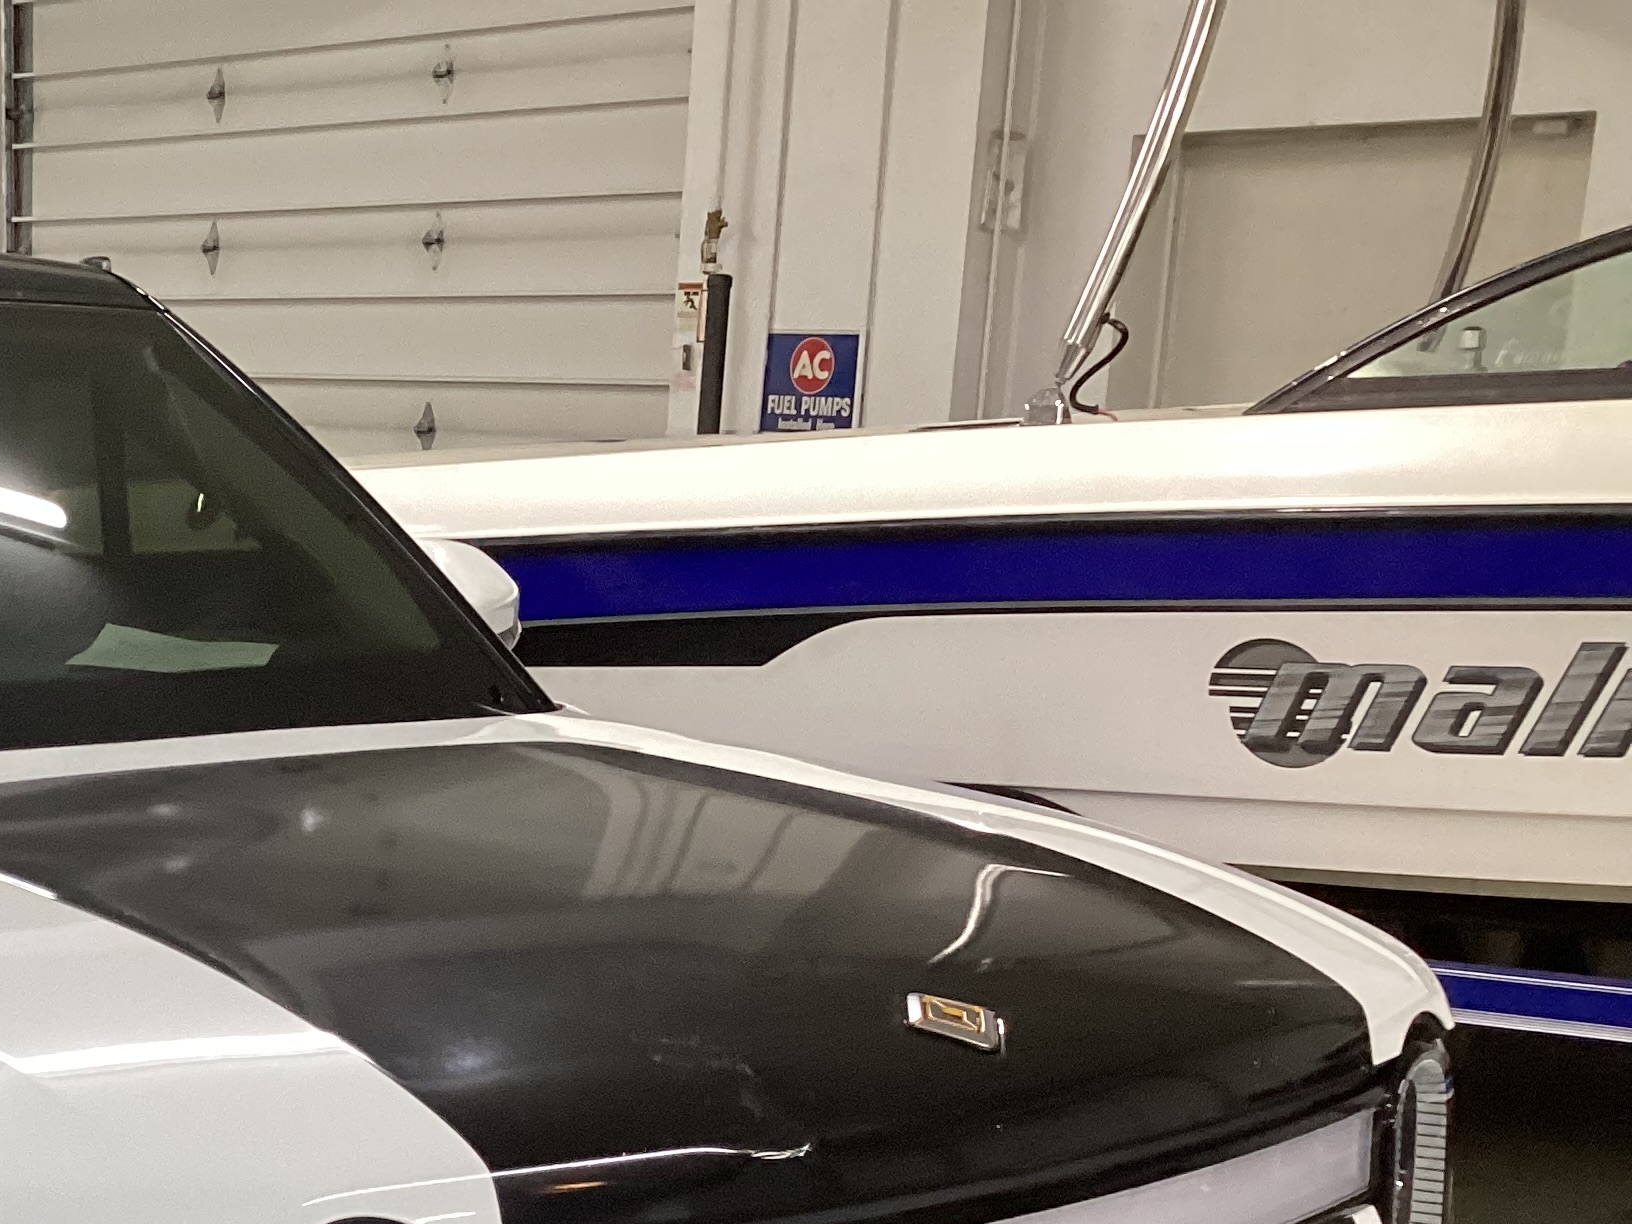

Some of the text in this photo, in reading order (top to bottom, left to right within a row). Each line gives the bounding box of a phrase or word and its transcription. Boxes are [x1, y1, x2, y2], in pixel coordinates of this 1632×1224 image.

[793, 349, 831, 380] AC
[767, 394, 851, 417] FUEL PUMPS
